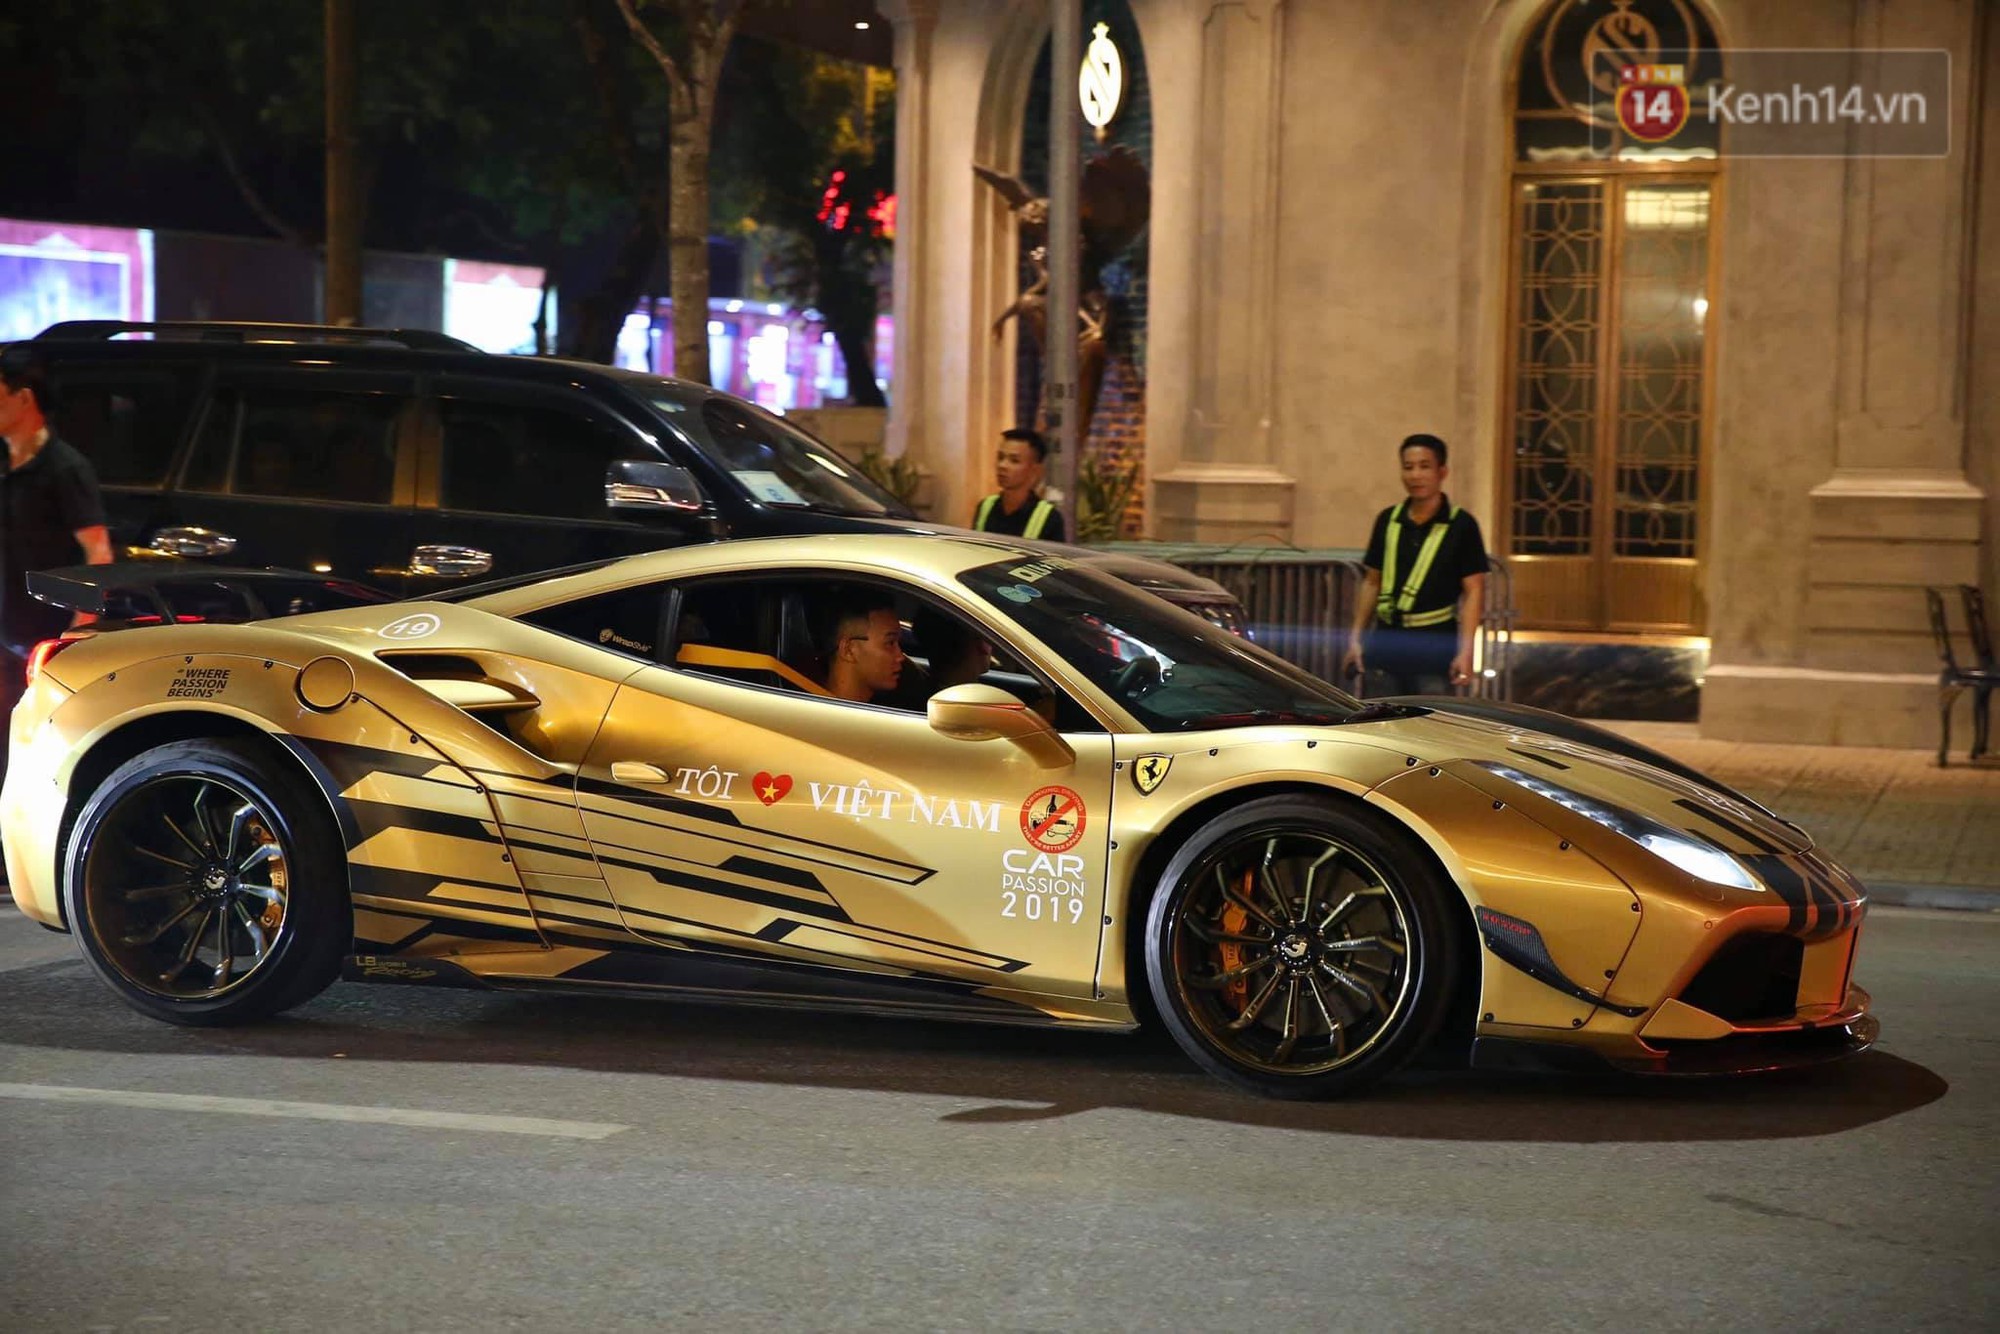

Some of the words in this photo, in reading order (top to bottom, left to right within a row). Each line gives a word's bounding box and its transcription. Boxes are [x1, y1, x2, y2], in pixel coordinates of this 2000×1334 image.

[391, 621, 430, 636] 19
[171, 678, 228, 689] PASSION
[674, 764, 739, 800] TÔI
[808, 778, 901, 823] VIỆT
[906, 793, 1003, 833] NAM
[1002, 848, 1085, 880] CAR
[1002, 873, 1085, 897] PASSION
[1001, 891, 1084, 925] 2019
